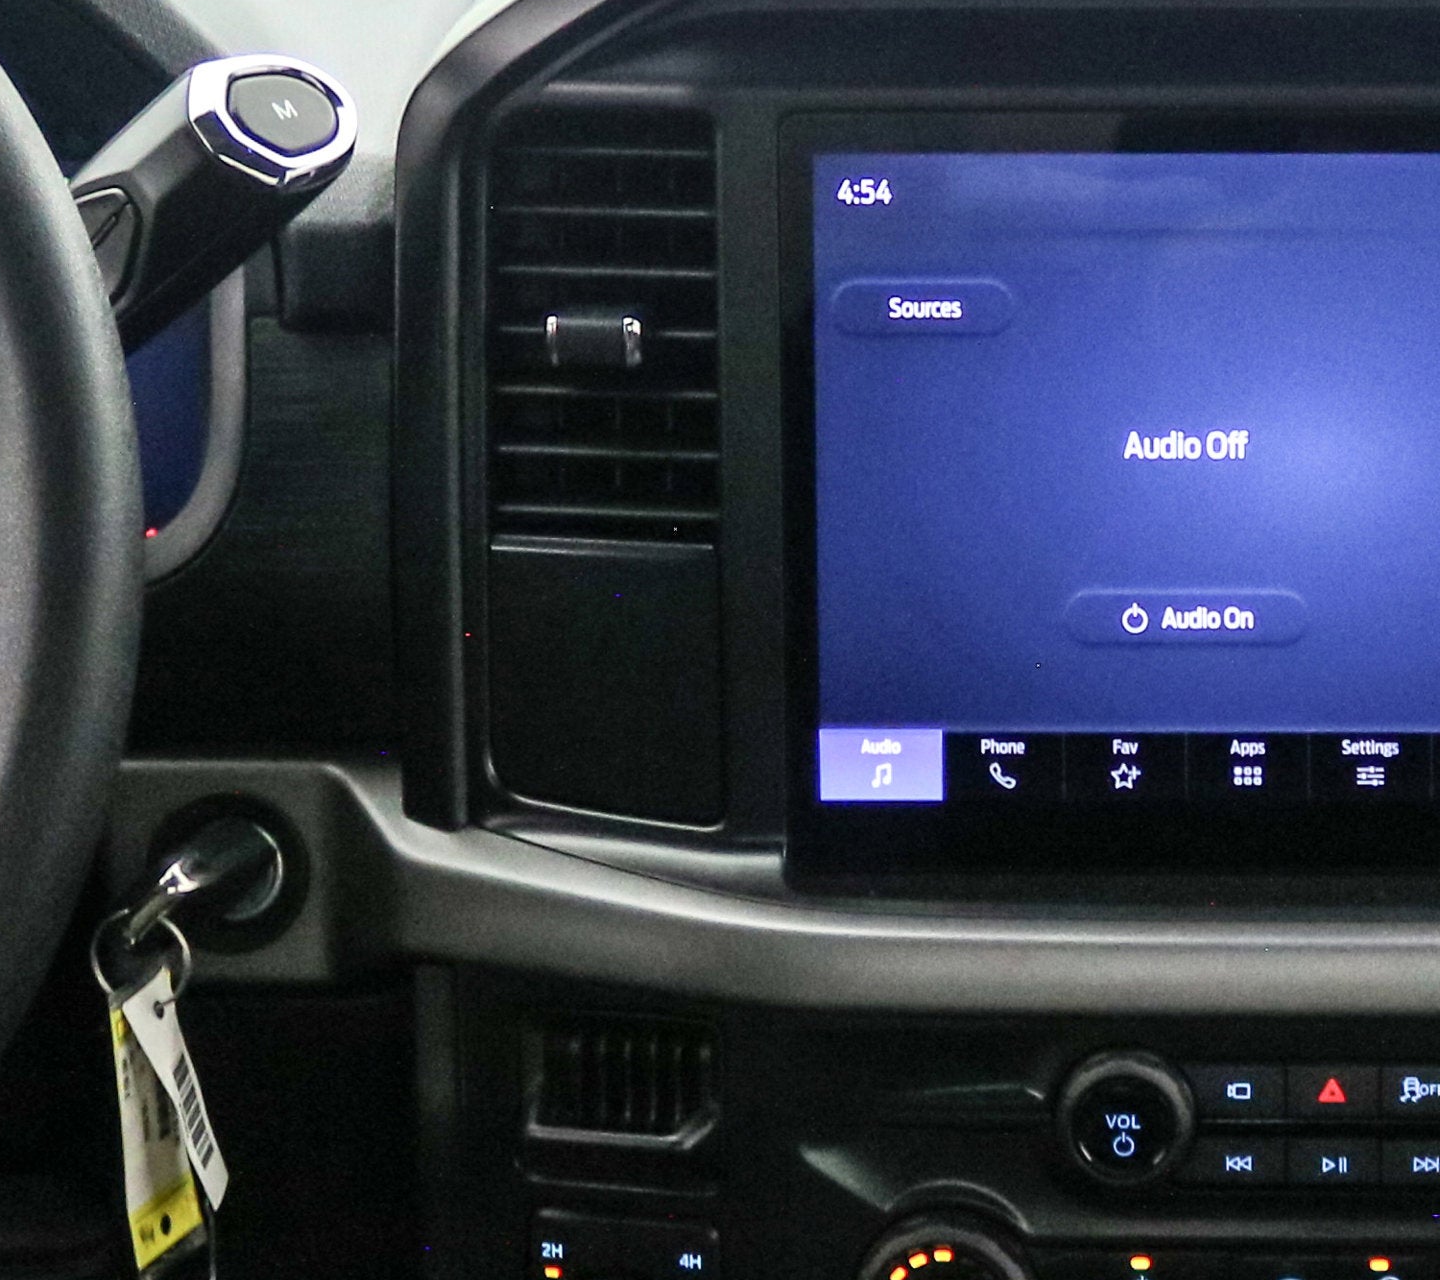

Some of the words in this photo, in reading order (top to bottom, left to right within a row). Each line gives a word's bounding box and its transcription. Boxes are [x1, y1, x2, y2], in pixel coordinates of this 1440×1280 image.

[837, 178, 893, 206] 4:54
[888, 296, 963, 320] Sources
[1123, 430, 1200, 461] Audio
[1205, 429, 1249, 461] Off
[1161, 606, 1221, 630] Audio
[1223, 606, 1254, 630] On
[860, 738, 901, 756] Audio
[980, 738, 1025, 756] Phone
[1112, 738, 1138, 756] Fav
[1230, 738, 1266, 760] Apps
[1341, 738, 1399, 760] Settings
[1105, 1115, 1140, 1130] VOL
[541, 1243, 563, 1258] 2H
[679, 1254, 702, 1269] 4H
